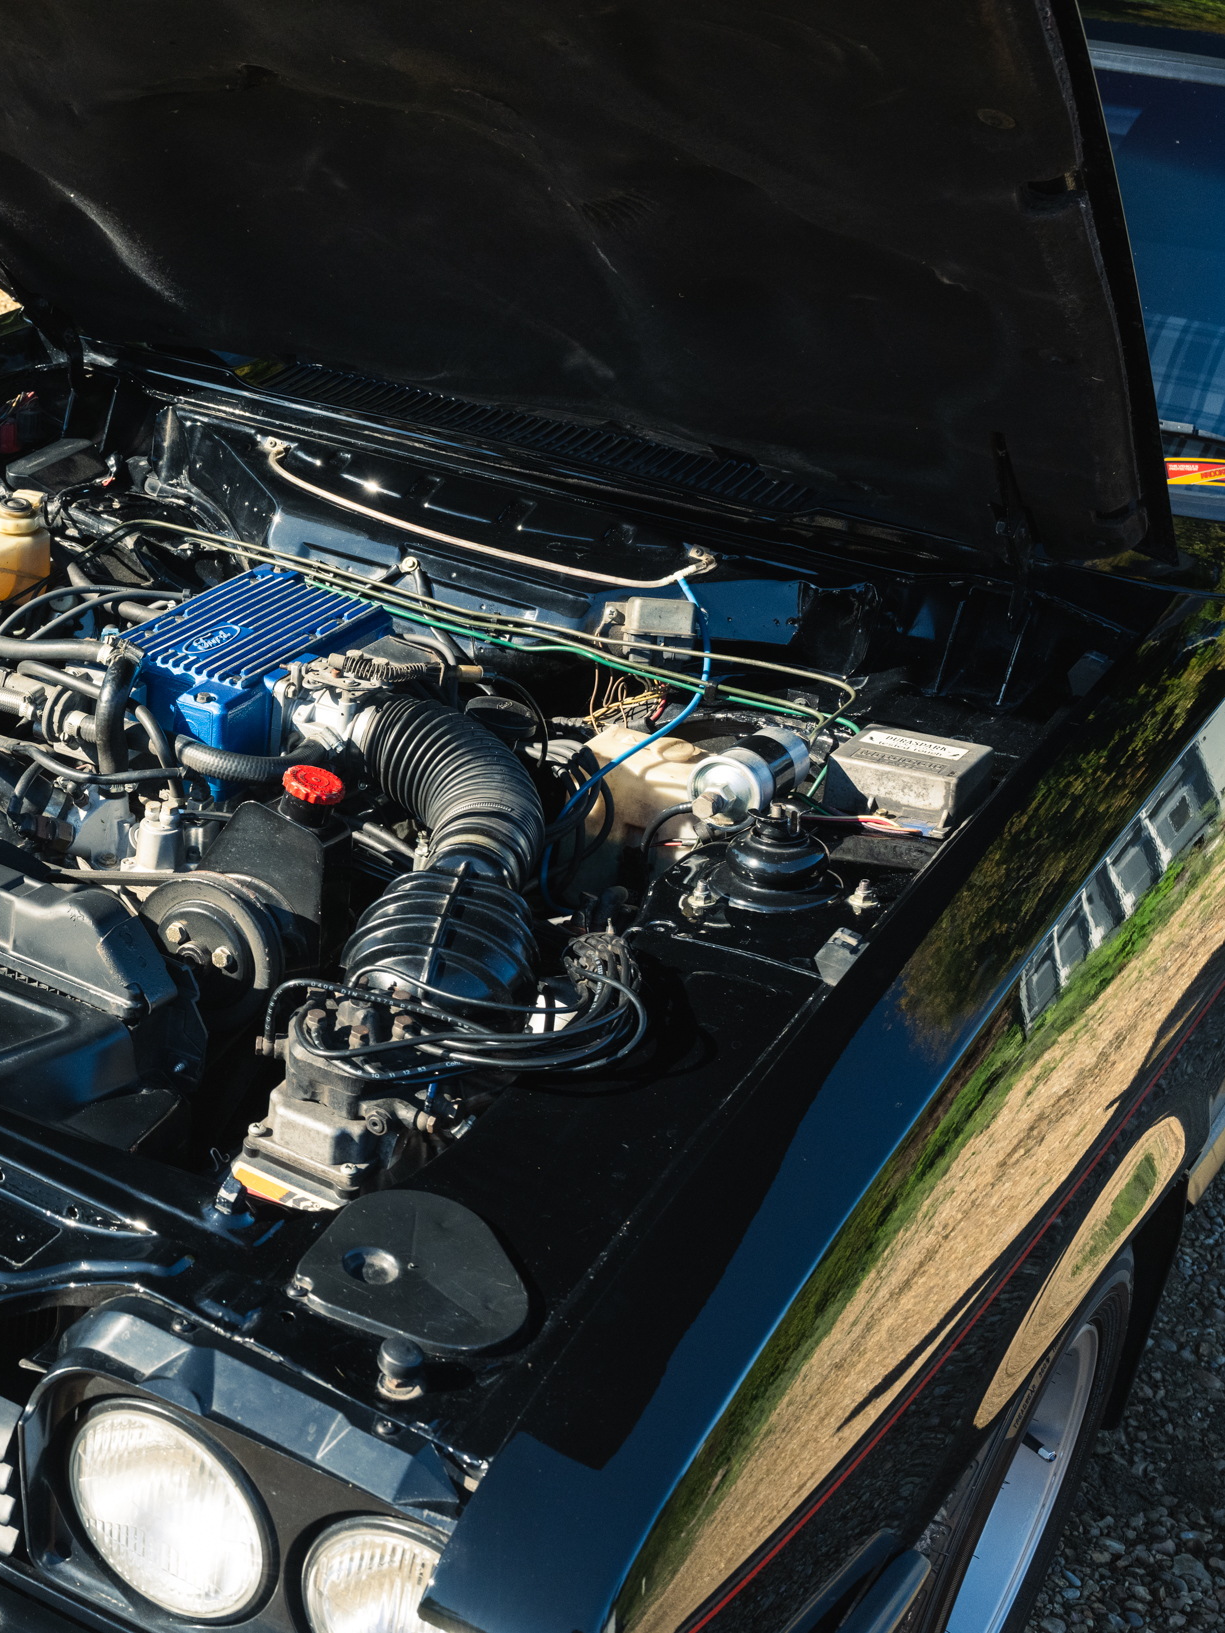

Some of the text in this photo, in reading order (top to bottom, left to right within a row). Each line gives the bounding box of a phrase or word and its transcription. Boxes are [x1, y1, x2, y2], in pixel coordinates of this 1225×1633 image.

[192, 630, 232, 651] Ford
[886, 735, 948, 752] DURASPARK
[310, 981, 334, 991] 0406
[340, 988, 358, 997] DIN
[1012, 1384, 1037, 1430] TREADWEAR
